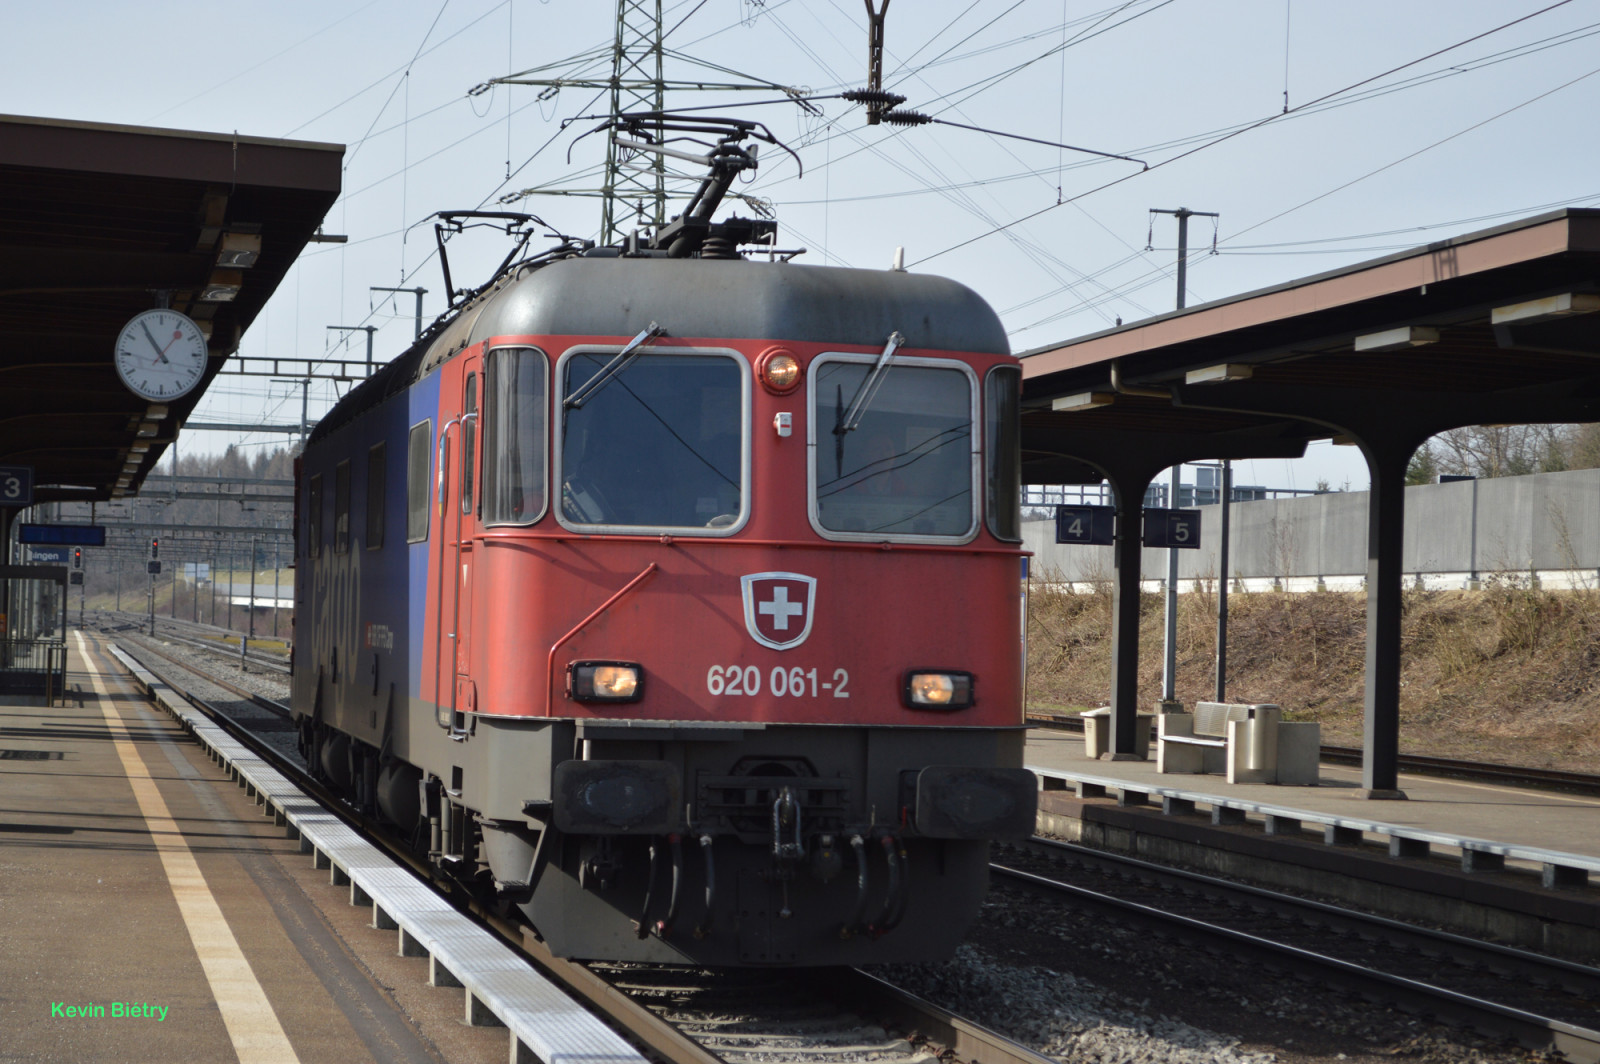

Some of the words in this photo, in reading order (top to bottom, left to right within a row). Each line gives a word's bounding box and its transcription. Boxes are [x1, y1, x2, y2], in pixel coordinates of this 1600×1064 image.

[4, 477, 21, 498] 3
[1068, 518, 1083, 538] 4
[1174, 522, 1190, 542] 5
[707, 665, 762, 697] 620
[770, 666, 850, 698] 061-2
